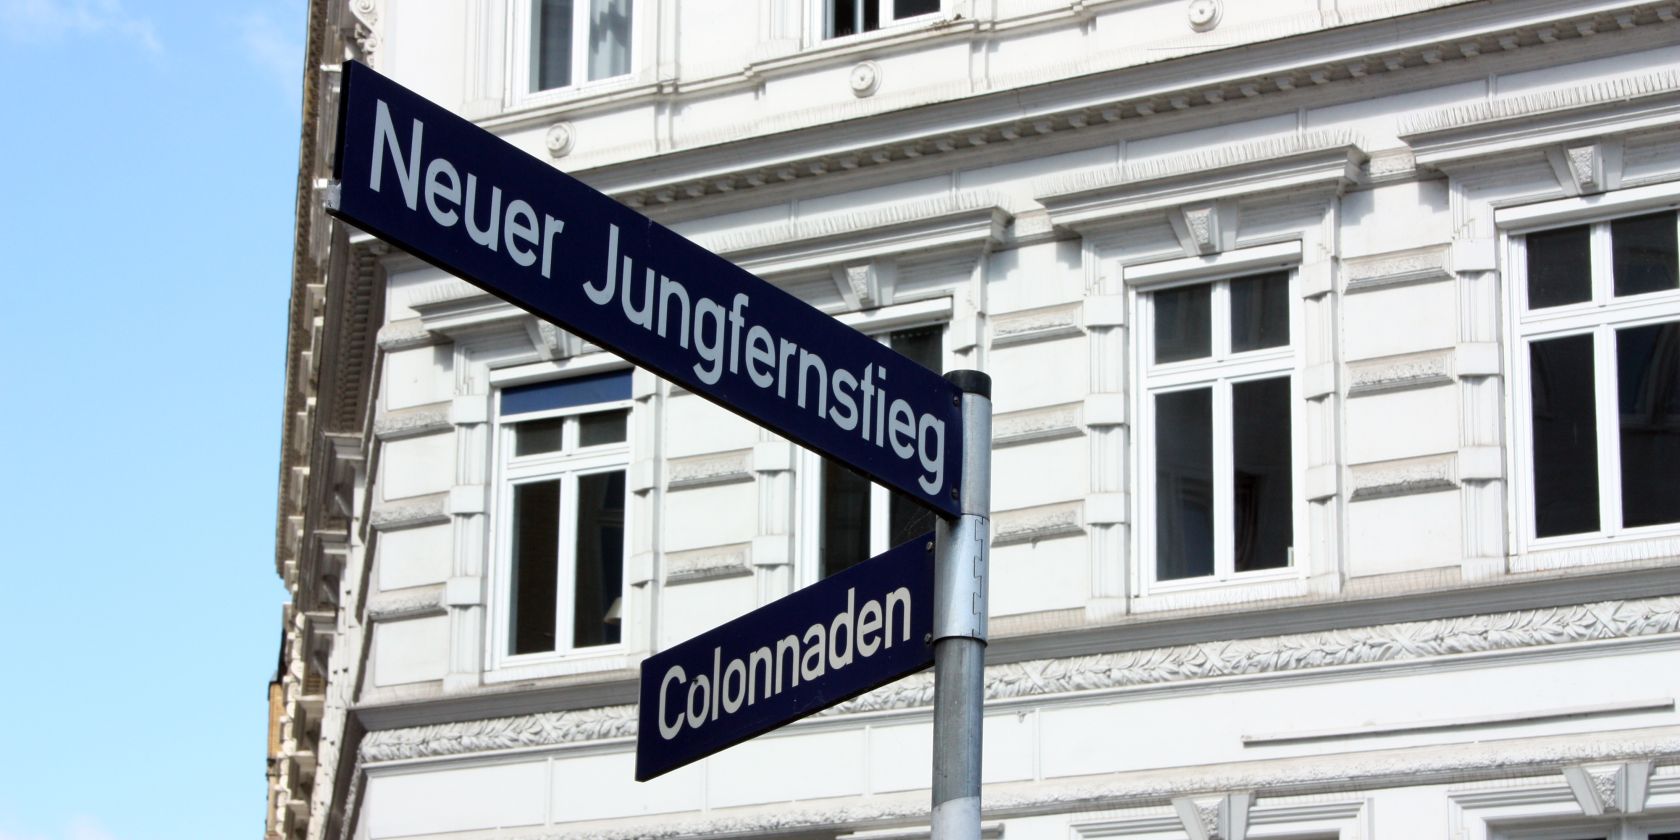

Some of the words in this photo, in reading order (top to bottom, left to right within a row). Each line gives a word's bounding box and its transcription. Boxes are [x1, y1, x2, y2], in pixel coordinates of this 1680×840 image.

[369, 99, 564, 279] Neuer
[583, 223, 945, 495] Jungfernstieg
[658, 586, 912, 740] Colonnaden
